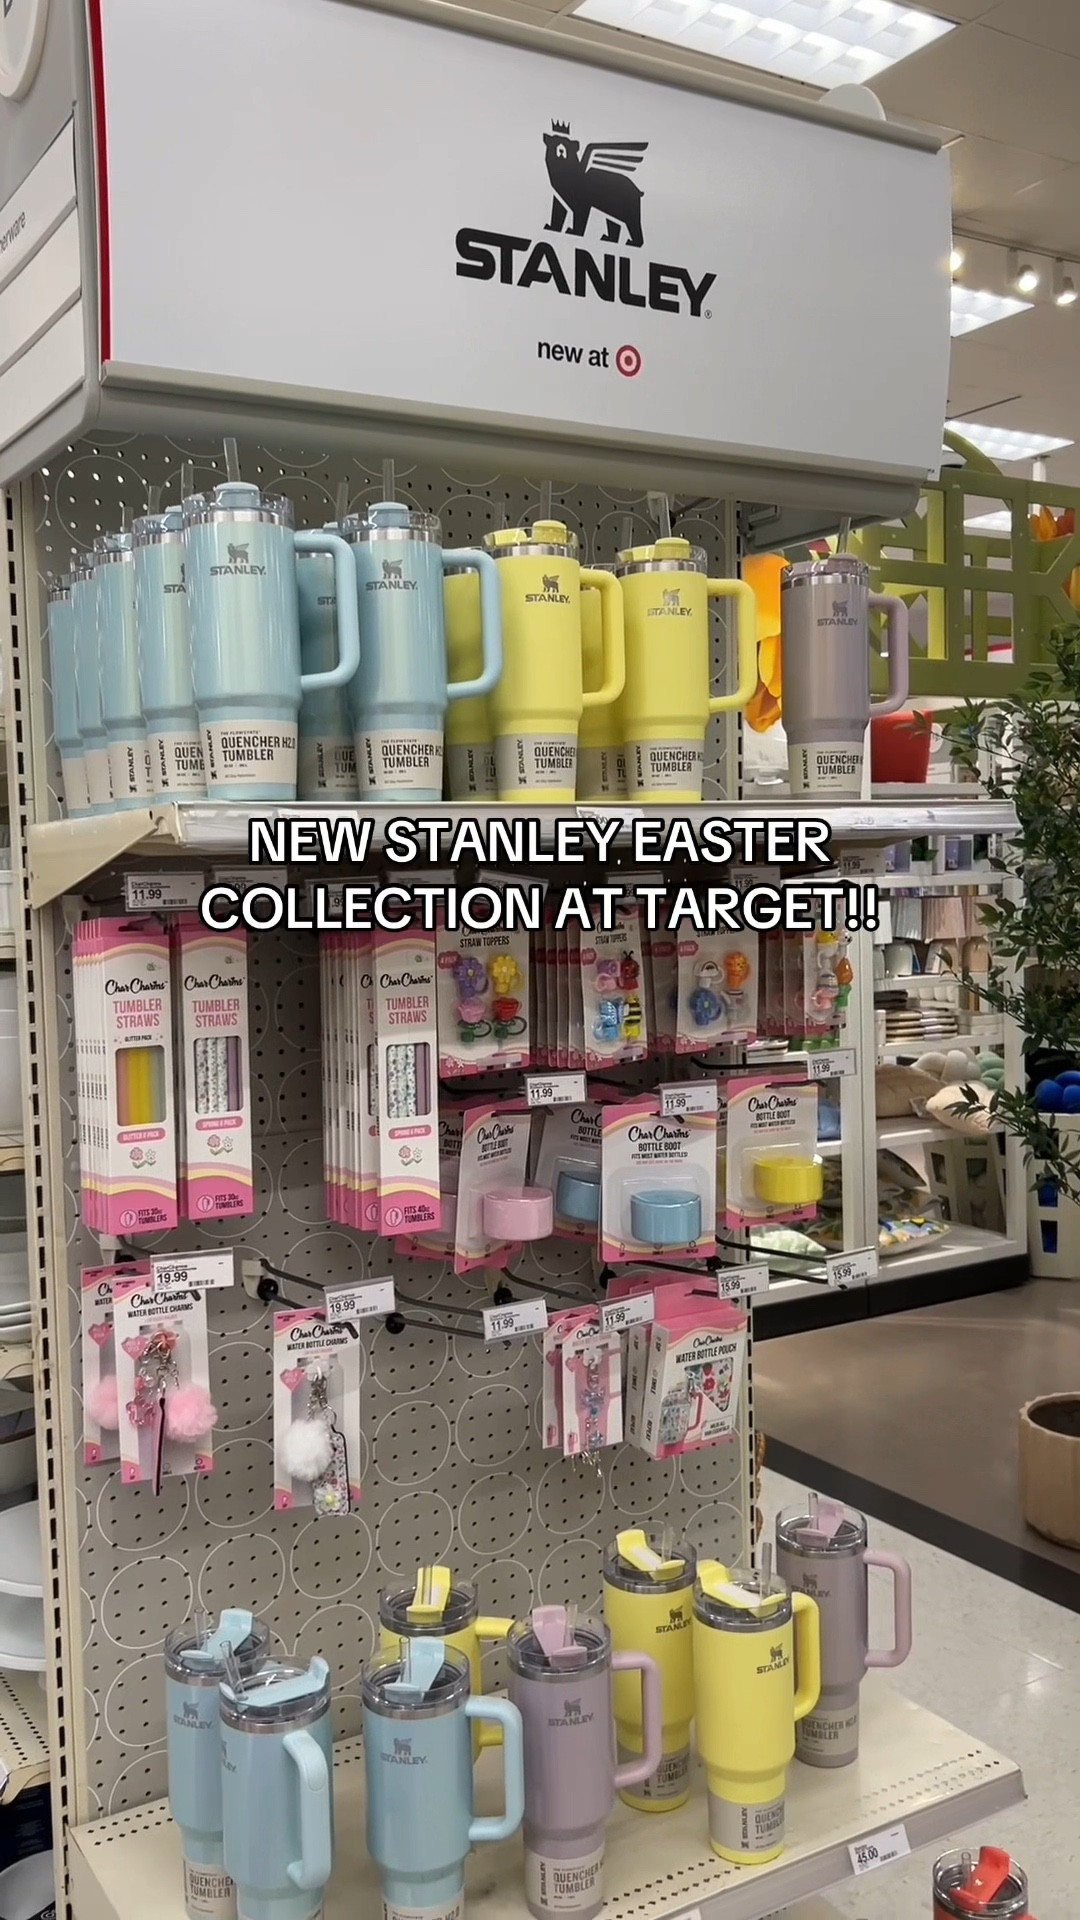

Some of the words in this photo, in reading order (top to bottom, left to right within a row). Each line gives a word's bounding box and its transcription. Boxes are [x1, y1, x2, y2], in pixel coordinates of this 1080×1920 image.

[0, 211, 26, 254] erware
[455, 227, 717, 317] STANLEY
[537, 341, 582, 363] new
[588, 346, 609, 368] at
[210, 565, 266, 576] STANLEY
[365, 581, 418, 591] STANLEY
[525, 594, 571, 604] STANLEY
[647, 607, 692, 617] STANLEY
[817, 617, 859, 627] STANLEY
[221, 735, 280, 750] QUENCHER
[175, 746, 204, 759] QUEN
[222, 749, 274, 761] TUMBLER
[381, 744, 434, 758] QUENCHER
[650, 751, 697, 762] QUENCHER
[382, 757, 430, 769] TUMBLER
[651, 761, 692, 772] TUMBLER
[817, 765, 856, 775] TUMBLER
[132, 888, 162, 900] 11.99
[460, 938, 481, 948] STRAW
[483, 935, 510, 946] TOPPERS
[113, 998, 163, 1014] TUMBLER
[192, 998, 240, 1013] TUMBLER
[386, 996, 429, 1010] TUMBLER
[116, 1013, 160, 1029] STRAWS
[195, 1013, 238, 1028] STRAWS
[389, 1010, 427, 1025] STRAWS
[812, 1063, 831, 1074] 11.99
[530, 1087, 553, 1099] 11.99
[665, 1099, 686, 1109] 11.99
[756, 1111, 775, 1121] BOTTLE
[776, 1109, 790, 1120] BOOT
[638, 1142, 663, 1153] BOTTLE
[664, 1141, 681, 1152] BOOT
[157, 1271, 188, 1284] 19.99
[833, 1267, 851, 1280] 15.99
[721, 1280, 741, 1293] 15.99
[127, 1308, 147, 1318] WATER
[148, 1306, 168, 1316] BOTTLE
[170, 1303, 193, 1313] CHARMS
[330, 1299, 355, 1313] 19.99
[491, 1318, 514, 1331] 11.99
[605, 1313, 625, 1325] 11.99
[287, 1343, 304, 1351] WATER
[305, 1340, 324, 1349] BOTTLE
[325, 1337, 348, 1346] CHARMS
[675, 1351, 696, 1364] WATER
[696, 1347, 717, 1359] BOTTLE
[718, 1342, 737, 1355] POUCH
[656, 1617, 691, 1634] STANLEY
[757, 1657, 789, 1674] STANLEY
[548, 1712, 594, 1727] STANLEY
[380, 1752, 426, 1765] STANLEY
[858, 1847, 878, 1864] 45.00
[553, 1862, 599, 1883] QUENCHER
[554, 1876, 595, 1894] TUMBLER
